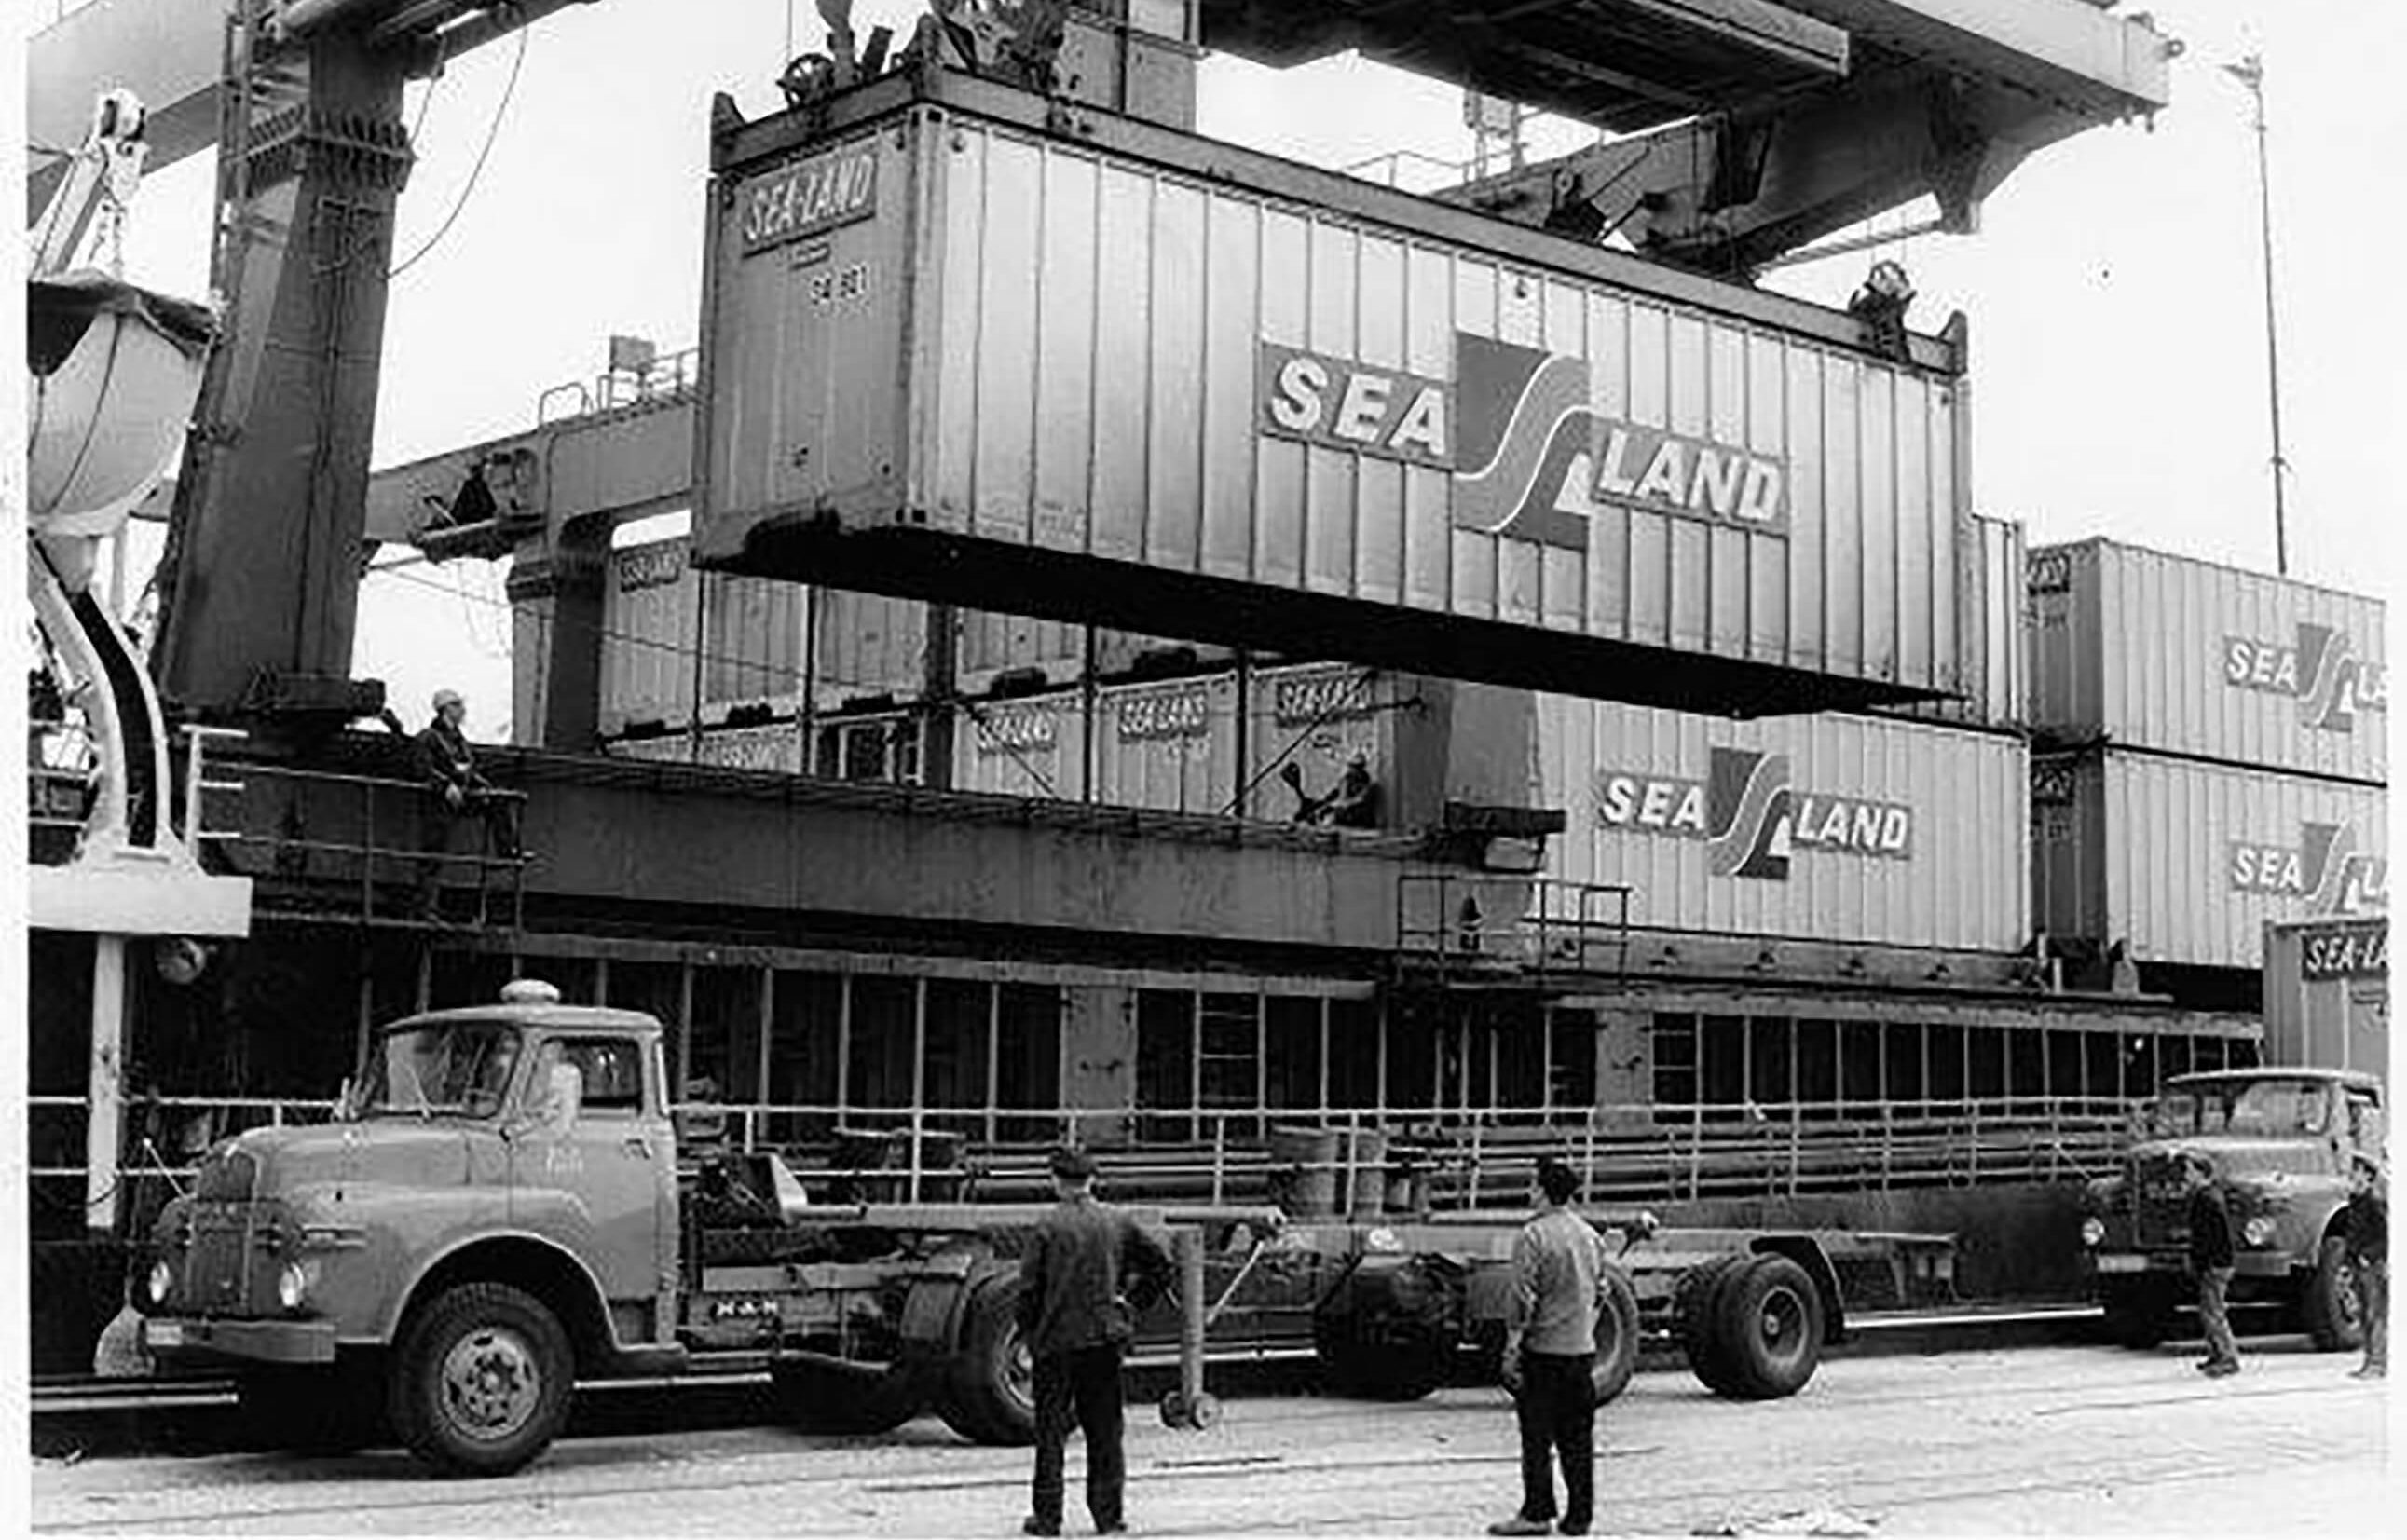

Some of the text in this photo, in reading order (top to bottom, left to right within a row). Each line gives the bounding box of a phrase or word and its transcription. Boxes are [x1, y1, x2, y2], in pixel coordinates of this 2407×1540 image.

[1271, 358, 1782, 522] SEA LAND
[2227, 643, 2298, 689] SEA
[1601, 777, 1911, 850] SEA LAND
[2234, 847, 2302, 889] SEA
